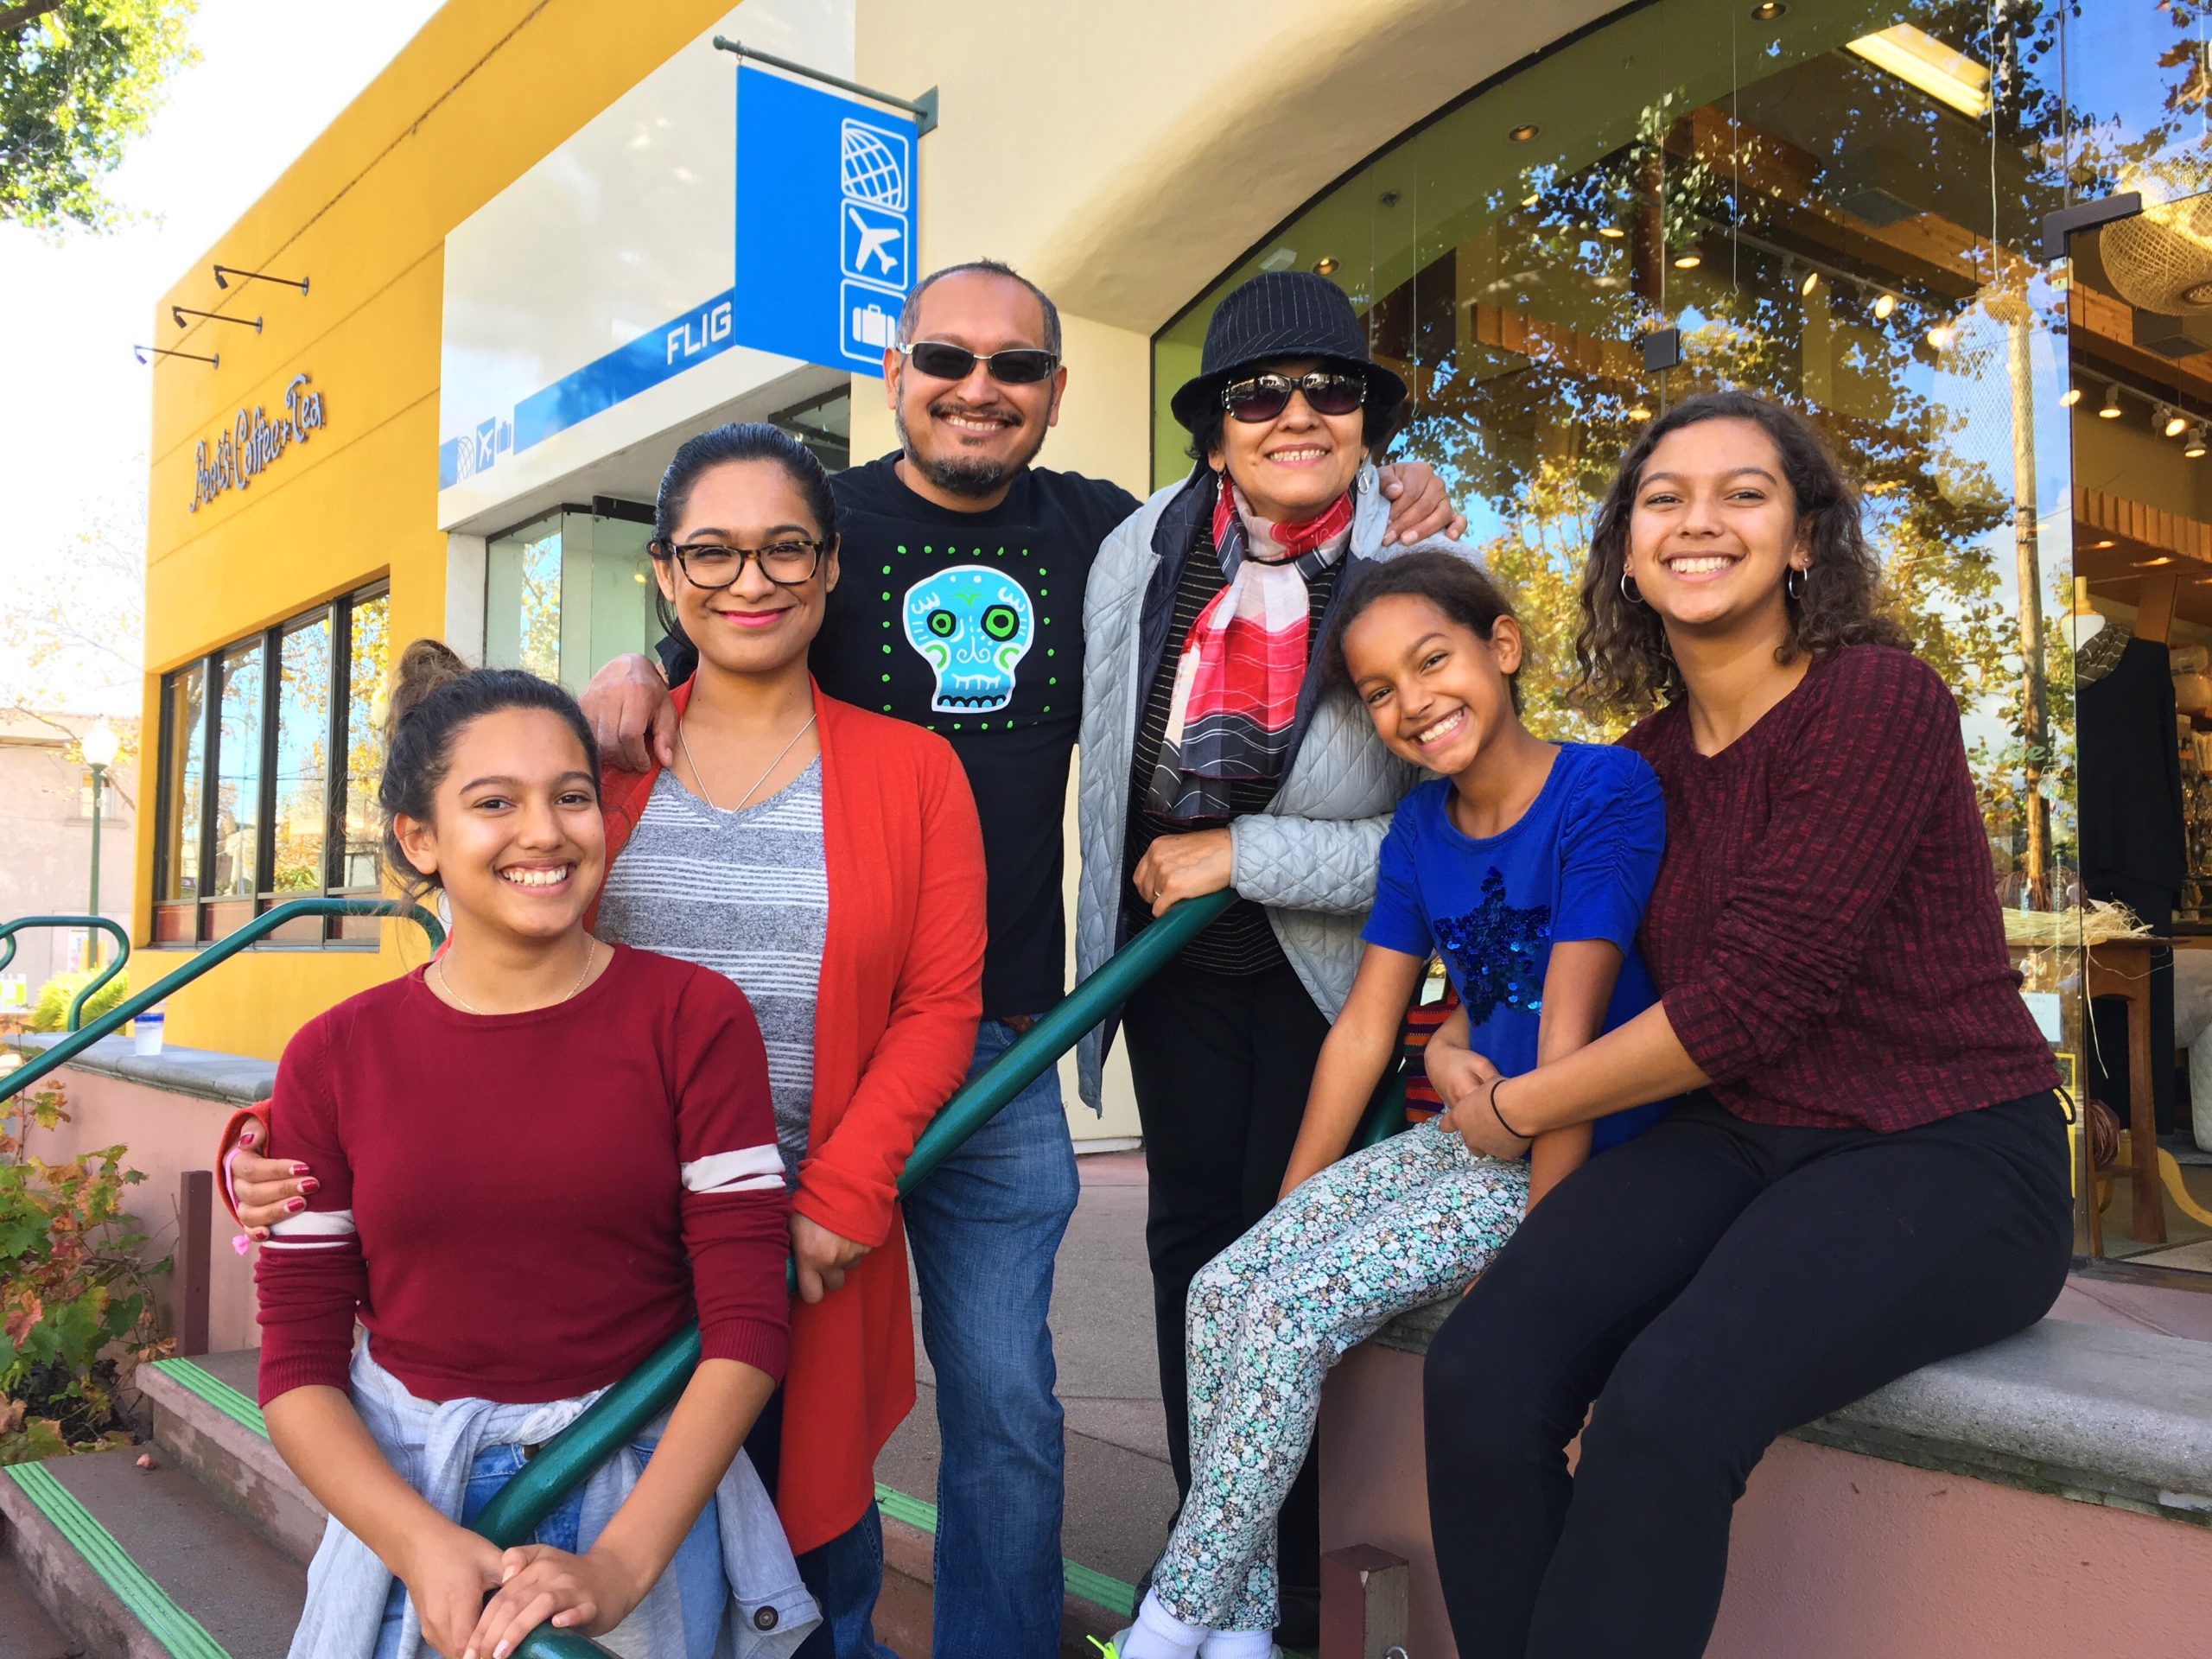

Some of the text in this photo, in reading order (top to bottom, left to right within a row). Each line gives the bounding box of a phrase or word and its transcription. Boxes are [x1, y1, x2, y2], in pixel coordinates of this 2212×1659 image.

[667, 301, 732, 365] FLIG
[189, 429, 231, 512] Peet's
[233, 406, 281, 490] Coffee
[284, 373, 322, 443] Tea
